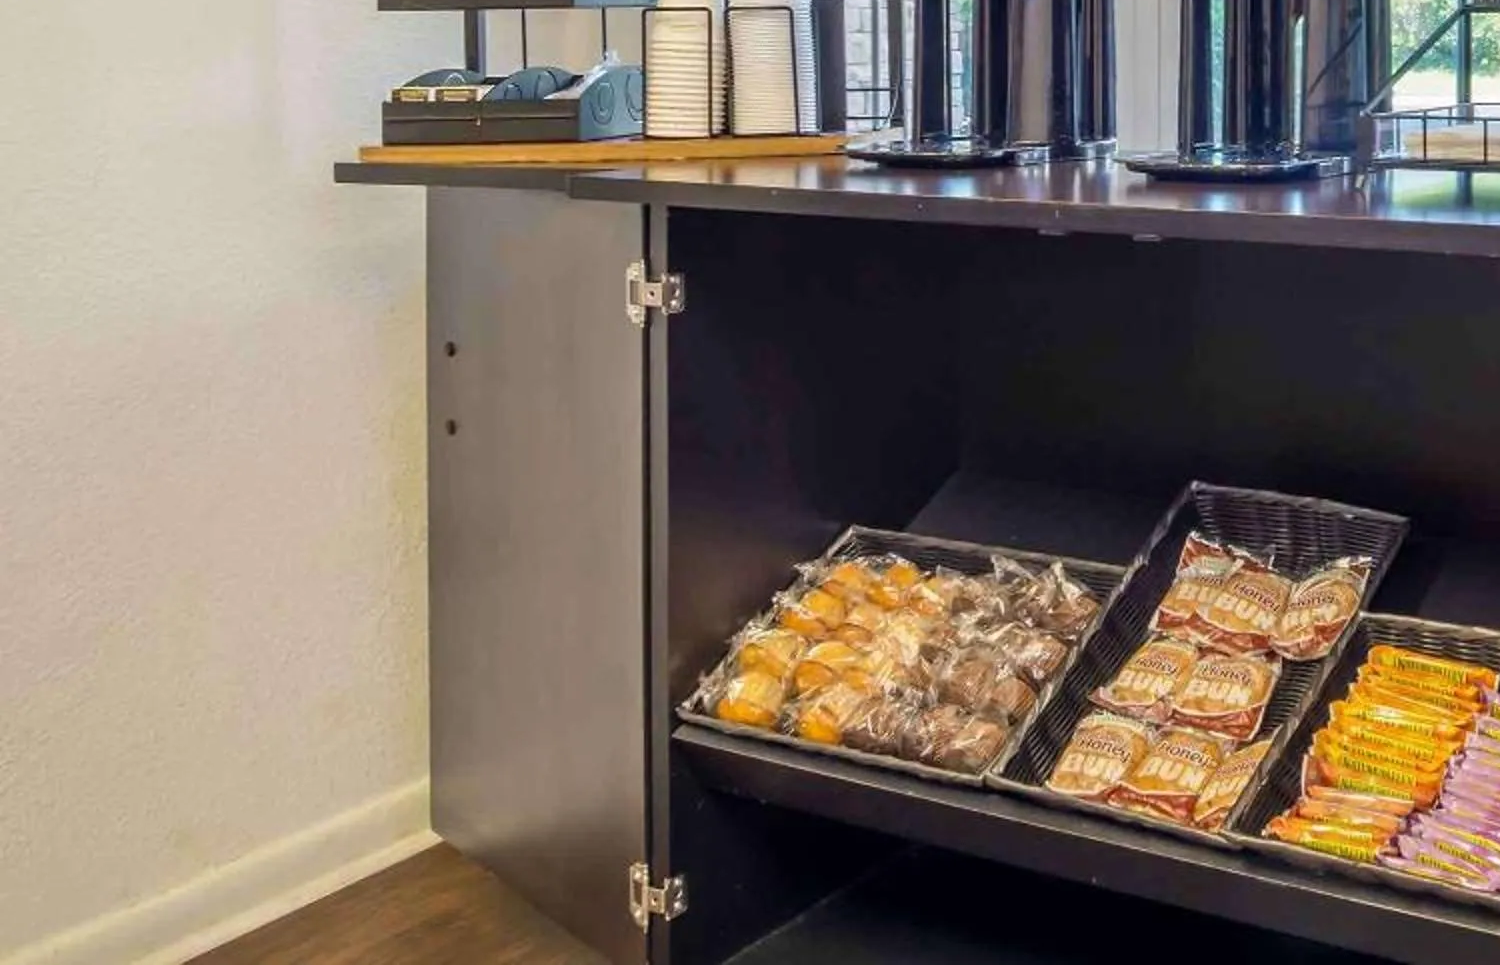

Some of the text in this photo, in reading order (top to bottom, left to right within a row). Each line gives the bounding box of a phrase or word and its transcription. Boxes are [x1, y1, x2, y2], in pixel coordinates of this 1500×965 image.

[1233, 583, 1282, 613] Honey
[1135, 656, 1182, 678] Honey
[1200, 663, 1252, 684] Honey
[1116, 668, 1175, 697] BUN
[1185, 678, 1253, 709] BUN
[1078, 736, 1134, 764] Honey
[1158, 740, 1215, 768] Honey
[1061, 752, 1125, 783] BUN
